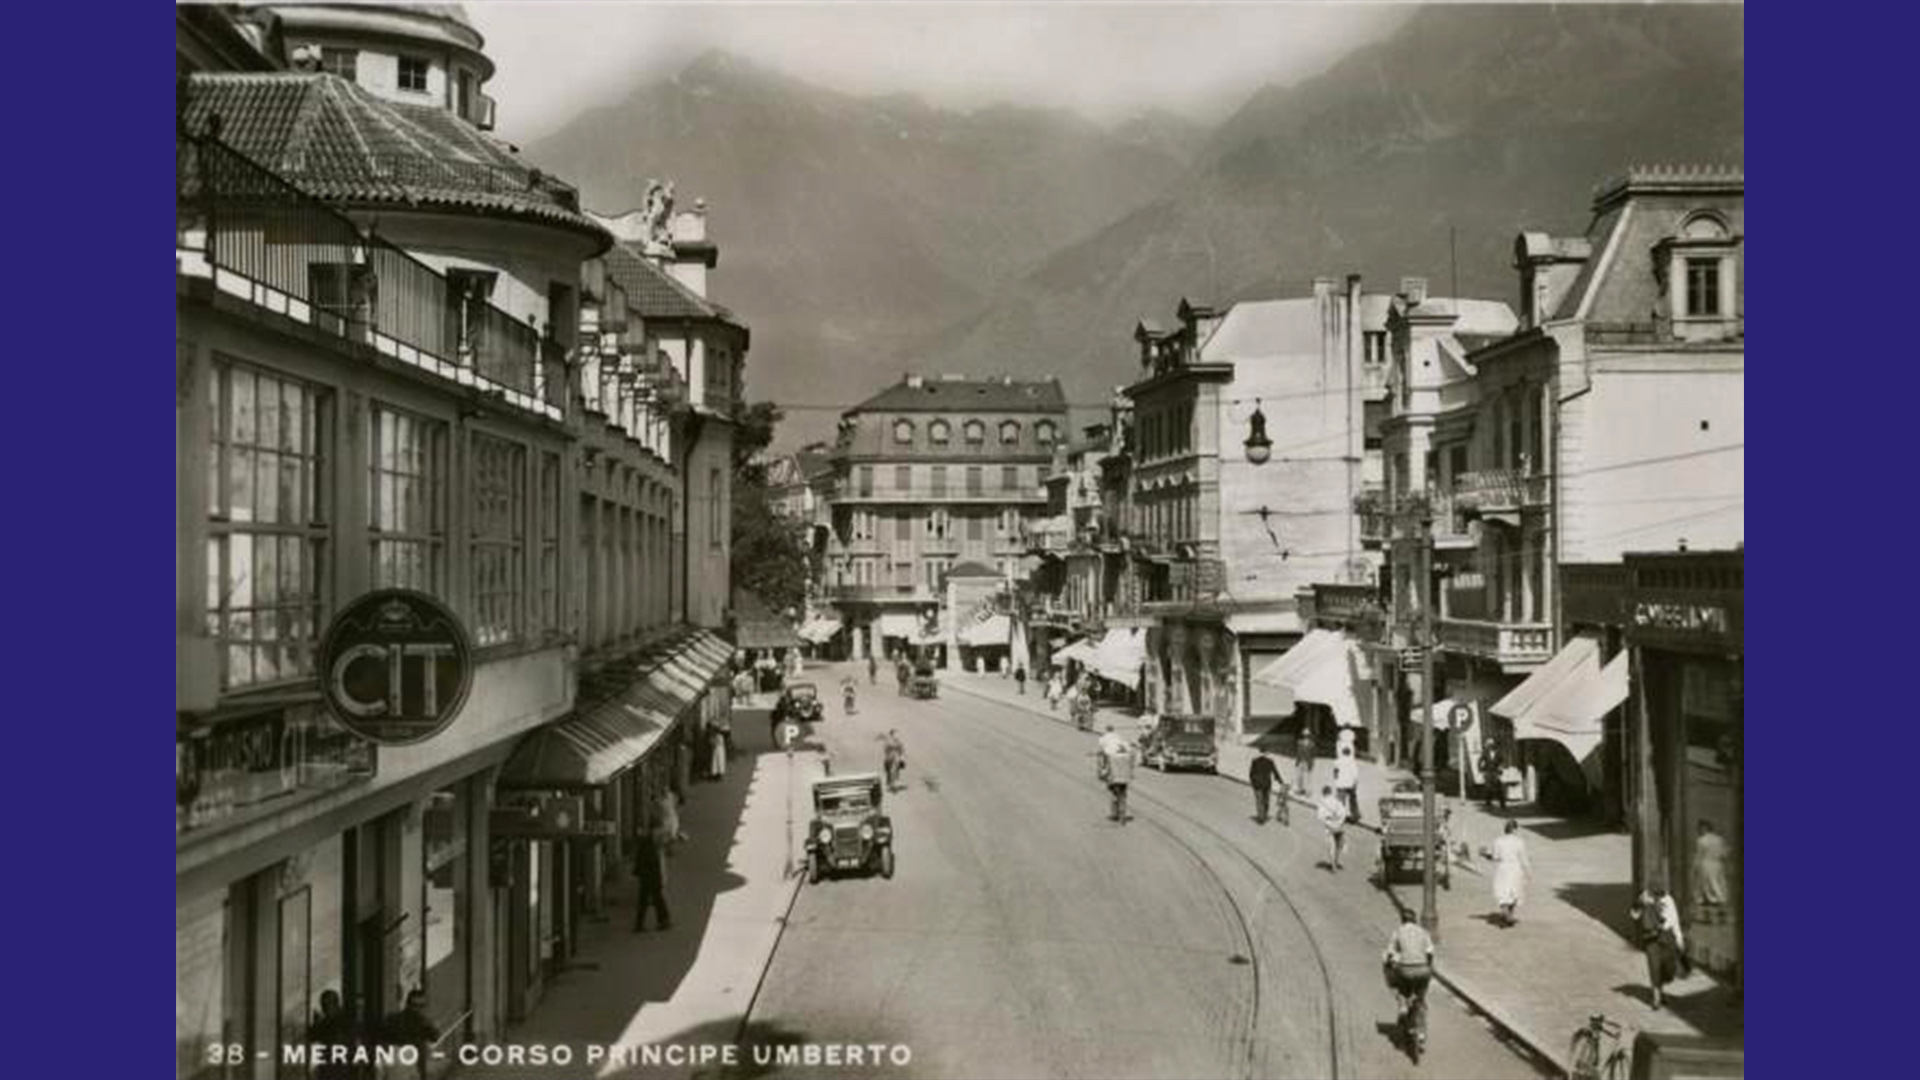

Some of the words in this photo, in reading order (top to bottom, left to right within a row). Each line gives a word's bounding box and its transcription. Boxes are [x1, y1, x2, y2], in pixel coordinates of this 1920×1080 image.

[331, 643, 456, 717] CIT
[1455, 708, 1469, 728] P
[785, 724, 800, 745] P
